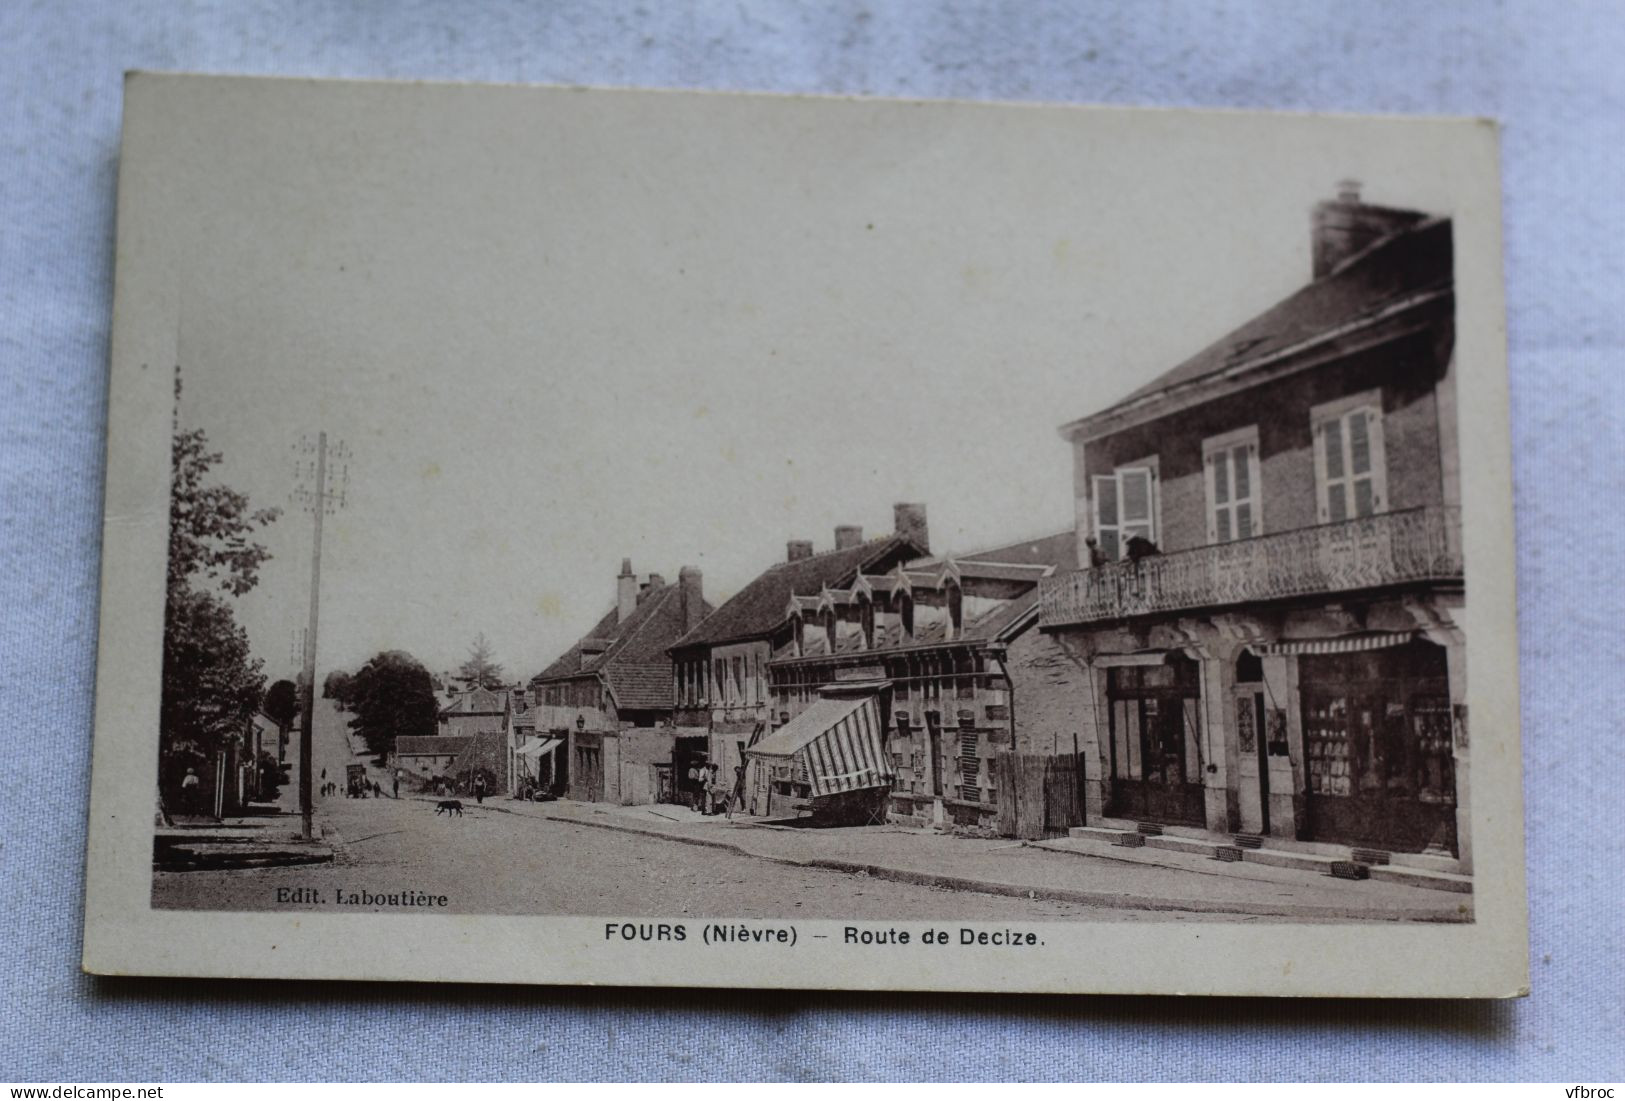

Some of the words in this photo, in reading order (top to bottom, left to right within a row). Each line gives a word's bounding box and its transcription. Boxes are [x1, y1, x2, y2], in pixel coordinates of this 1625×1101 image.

[276, 886, 326, 905] Edit.
[335, 888, 449, 908] Laboutière
[604, 923, 687, 941] FOURS
[702, 924, 798, 946] (Nièvre)
[843, 926, 911, 945] Route
[921, 927, 950, 946] de
[959, 928, 1046, 947] Decize.
